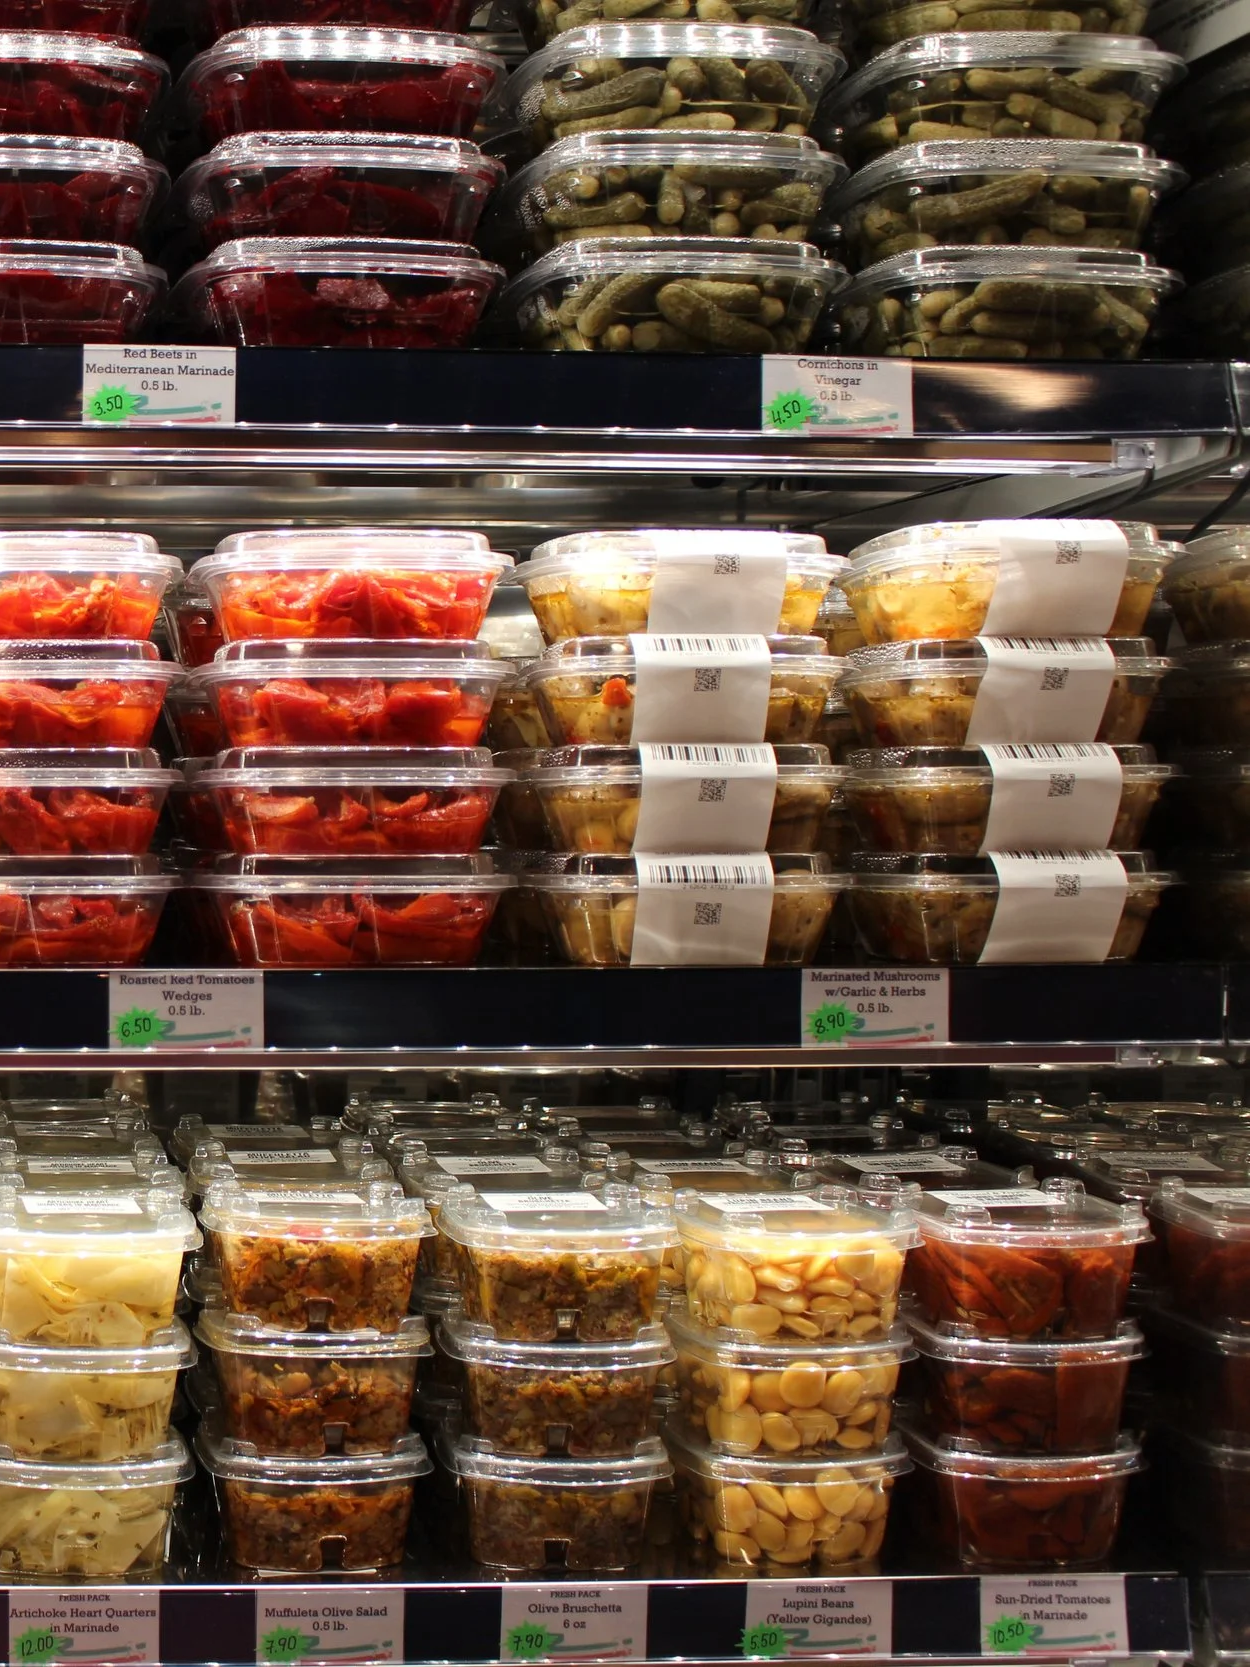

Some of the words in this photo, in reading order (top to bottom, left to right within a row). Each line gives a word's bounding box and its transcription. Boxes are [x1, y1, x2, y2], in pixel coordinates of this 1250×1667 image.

[124, 348, 147, 359] Red
[151, 348, 182, 359] Beets
[185, 349, 196, 359] in
[86, 364, 174, 375] Mediterranean
[178, 366, 234, 376] Marinade
[797, 359, 864, 370] Cornichons
[868, 360, 878, 370] in
[141, 381, 159, 390] 0.5
[162, 381, 178, 390] lb.
[815, 375, 861, 388] Vinegar
[820, 391, 837, 401] 0.5
[841, 391, 855, 401] lb.
[94, 395, 123, 416] 3.50
[772, 400, 801, 425] 4.50
[120, 975, 166, 985] Roasted
[197, 975, 254, 985] Tomatoes
[811, 972, 870, 981] Marinated
[874, 972, 940, 981] Mushrooms
[162, 991, 212, 1003] Wedges
[826, 987, 876, 997] w/Garlic
[879, 987, 888, 996] &
[891, 987, 926, 996] Herbs
[169, 1006, 187, 1015] 0.5
[190, 1006, 205, 1015] lb.
[857, 1003, 875, 1013] 0.5
[878, 1003, 892, 1013] lb.
[121, 1018, 151, 1038] 6.50
[815, 1012, 845, 1034] 8.90
[782, 1599, 818, 1610] Lupini
[821, 1599, 854, 1608] Beans
[995, 1594, 1052, 1604] Sun-Dried
[1055, 1594, 1110, 1604] Tomatoes
[10, 1608, 66, 1618] Artichoke
[70, 1608, 102, 1618] Heart
[105, 1608, 156, 1618] Quarters
[265, 1608, 319, 1617] Muffuleta
[322, 1607, 353, 1617] Olive
[357, 1607, 387, 1617] Salad
[528, 1604, 559, 1613] Olive
[563, 1604, 622, 1613] Bruschetta
[767, 1614, 810, 1625] (Yellow
[813, 1614, 871, 1626] Gigandes)
[1033, 1610, 1087, 1620] Marinade
[50, 1623, 61, 1633] in
[64, 1623, 119, 1633] Marinade
[313, 1621, 330, 1631] 0.5
[333, 1621, 347, 1631] lb.
[563, 1620, 569, 1629] 6
[572, 1621, 586, 1629] oz
[994, 1622, 1024, 1645] 10.50
[266, 1636, 297, 1654] 7.90
[513, 1634, 543, 1651] 7.90
[750, 1632, 777, 1649] 5.50
[22, 1636, 54, 1657] 12.00
